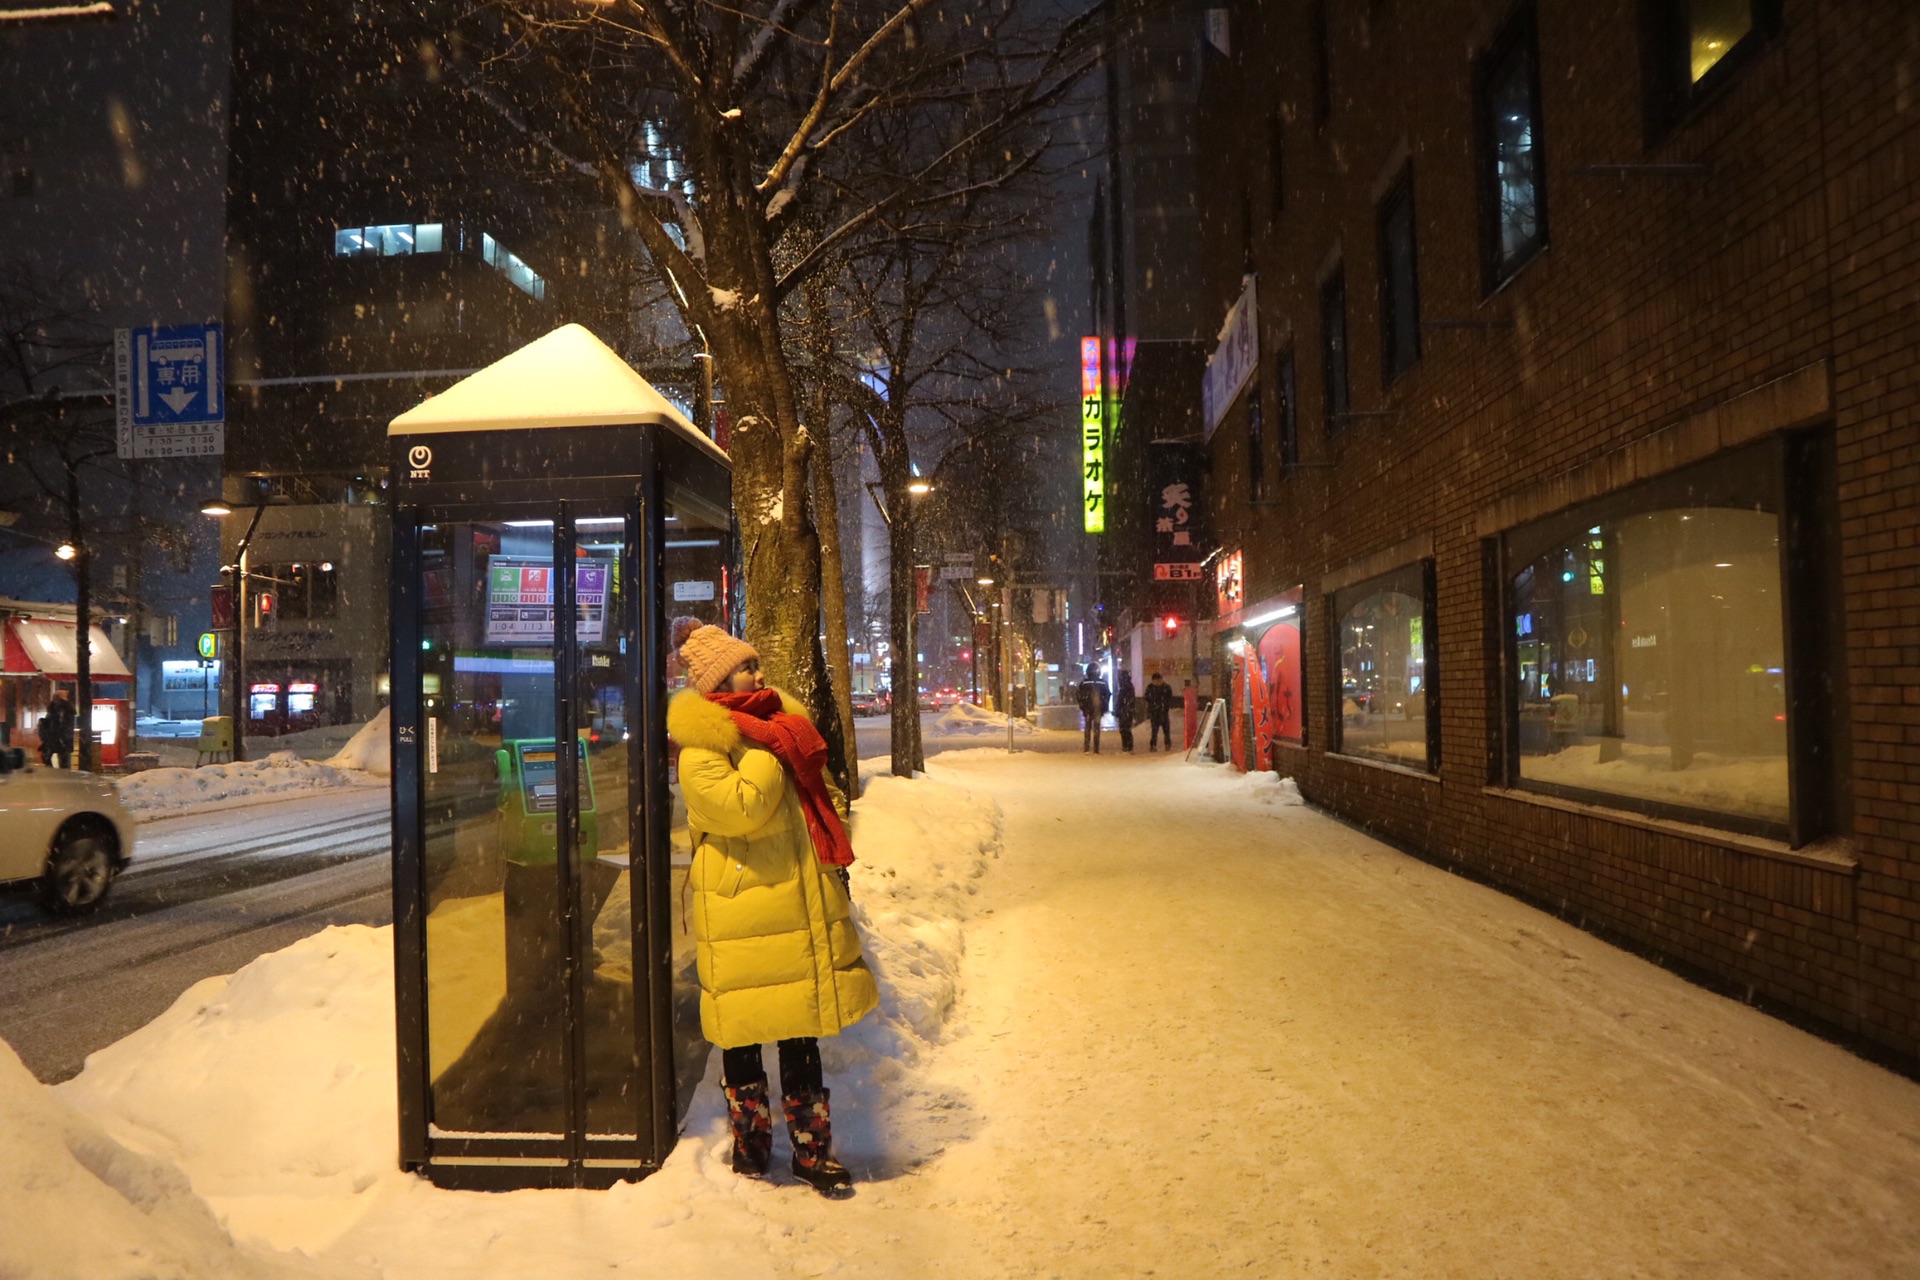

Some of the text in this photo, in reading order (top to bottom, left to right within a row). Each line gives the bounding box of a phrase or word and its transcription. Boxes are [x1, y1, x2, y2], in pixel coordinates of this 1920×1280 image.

[1085, 396, 1102, 512] カラオケ
[410, 469, 430, 478] NTT
[203, 636, 211, 653] P
[1249, 653, 1273, 754] ラーメン
[399, 725, 414, 734] ひく
